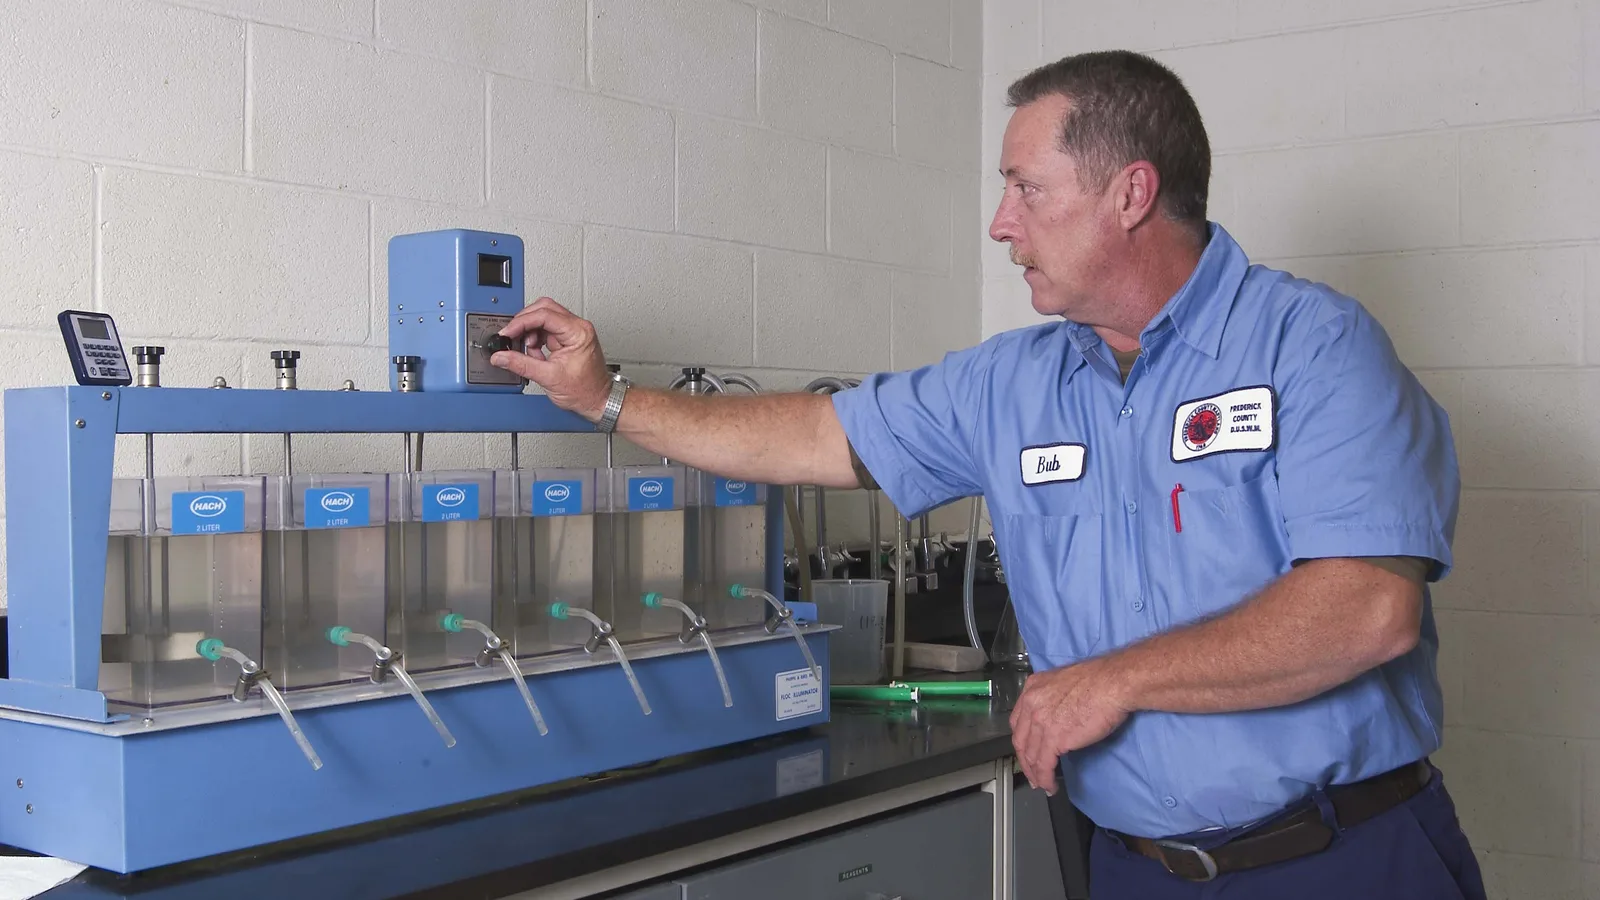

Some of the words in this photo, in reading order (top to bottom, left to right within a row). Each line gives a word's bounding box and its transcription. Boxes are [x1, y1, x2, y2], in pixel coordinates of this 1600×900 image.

[1230, 403, 1262, 413] FREDERICK
[1233, 414, 1258, 423] COUNTY
[1035, 453, 1061, 474] Bub
[440, 493, 462, 501] HACH
[547, 489, 567, 497] HACH
[325, 498, 350, 506] HACH
[194, 502, 222, 511] HACH
[332, 518, 349, 526] LITER
[202, 524, 221, 532] LITER
[780, 692, 791, 700] FLOC
